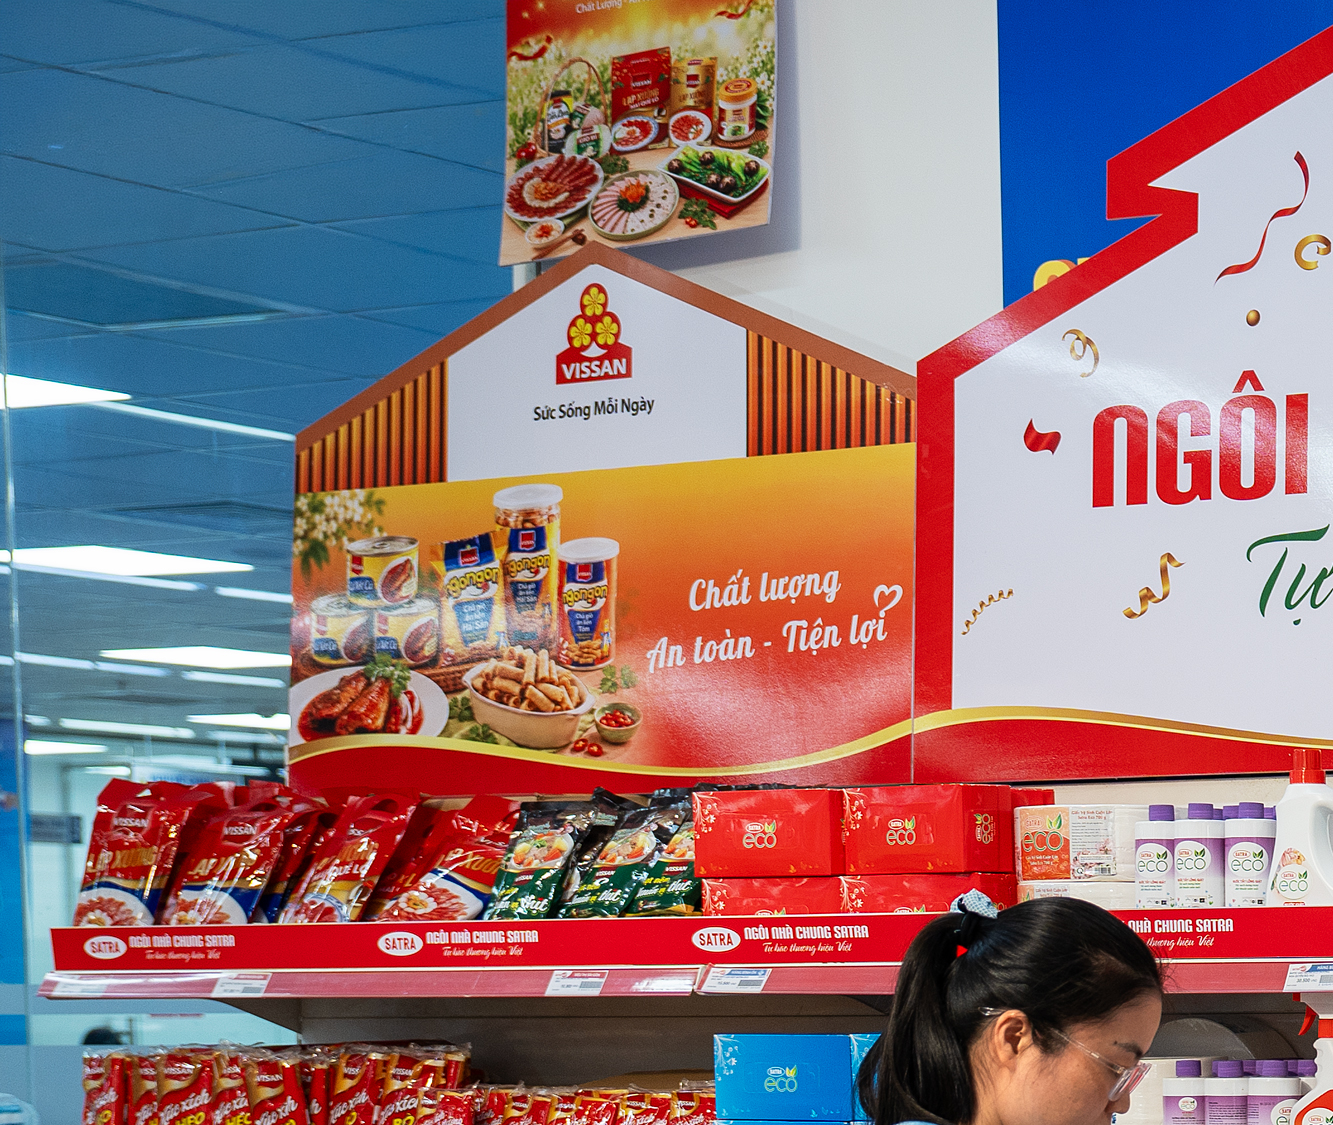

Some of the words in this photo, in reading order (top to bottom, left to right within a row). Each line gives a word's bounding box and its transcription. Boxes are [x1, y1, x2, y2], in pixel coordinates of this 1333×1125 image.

[562, 358, 626, 379] VISSAN
[534, 406, 556, 421] Sức
[559, 401, 591, 420] Sống
[594, 398, 617, 415] Mỗi
[621, 396, 654, 416] Ngày
[1091, 370, 1308, 507] NGÔI
[689, 569, 752, 611] Chất
[759, 571, 841, 604] lượng
[1247, 523, 1332, 628] Tự
[646, 637, 686, 673] An
[693, 629, 755, 663] toàn
[782, 617, 842, 655] Tiện
[850, 611, 887, 649] lợi
